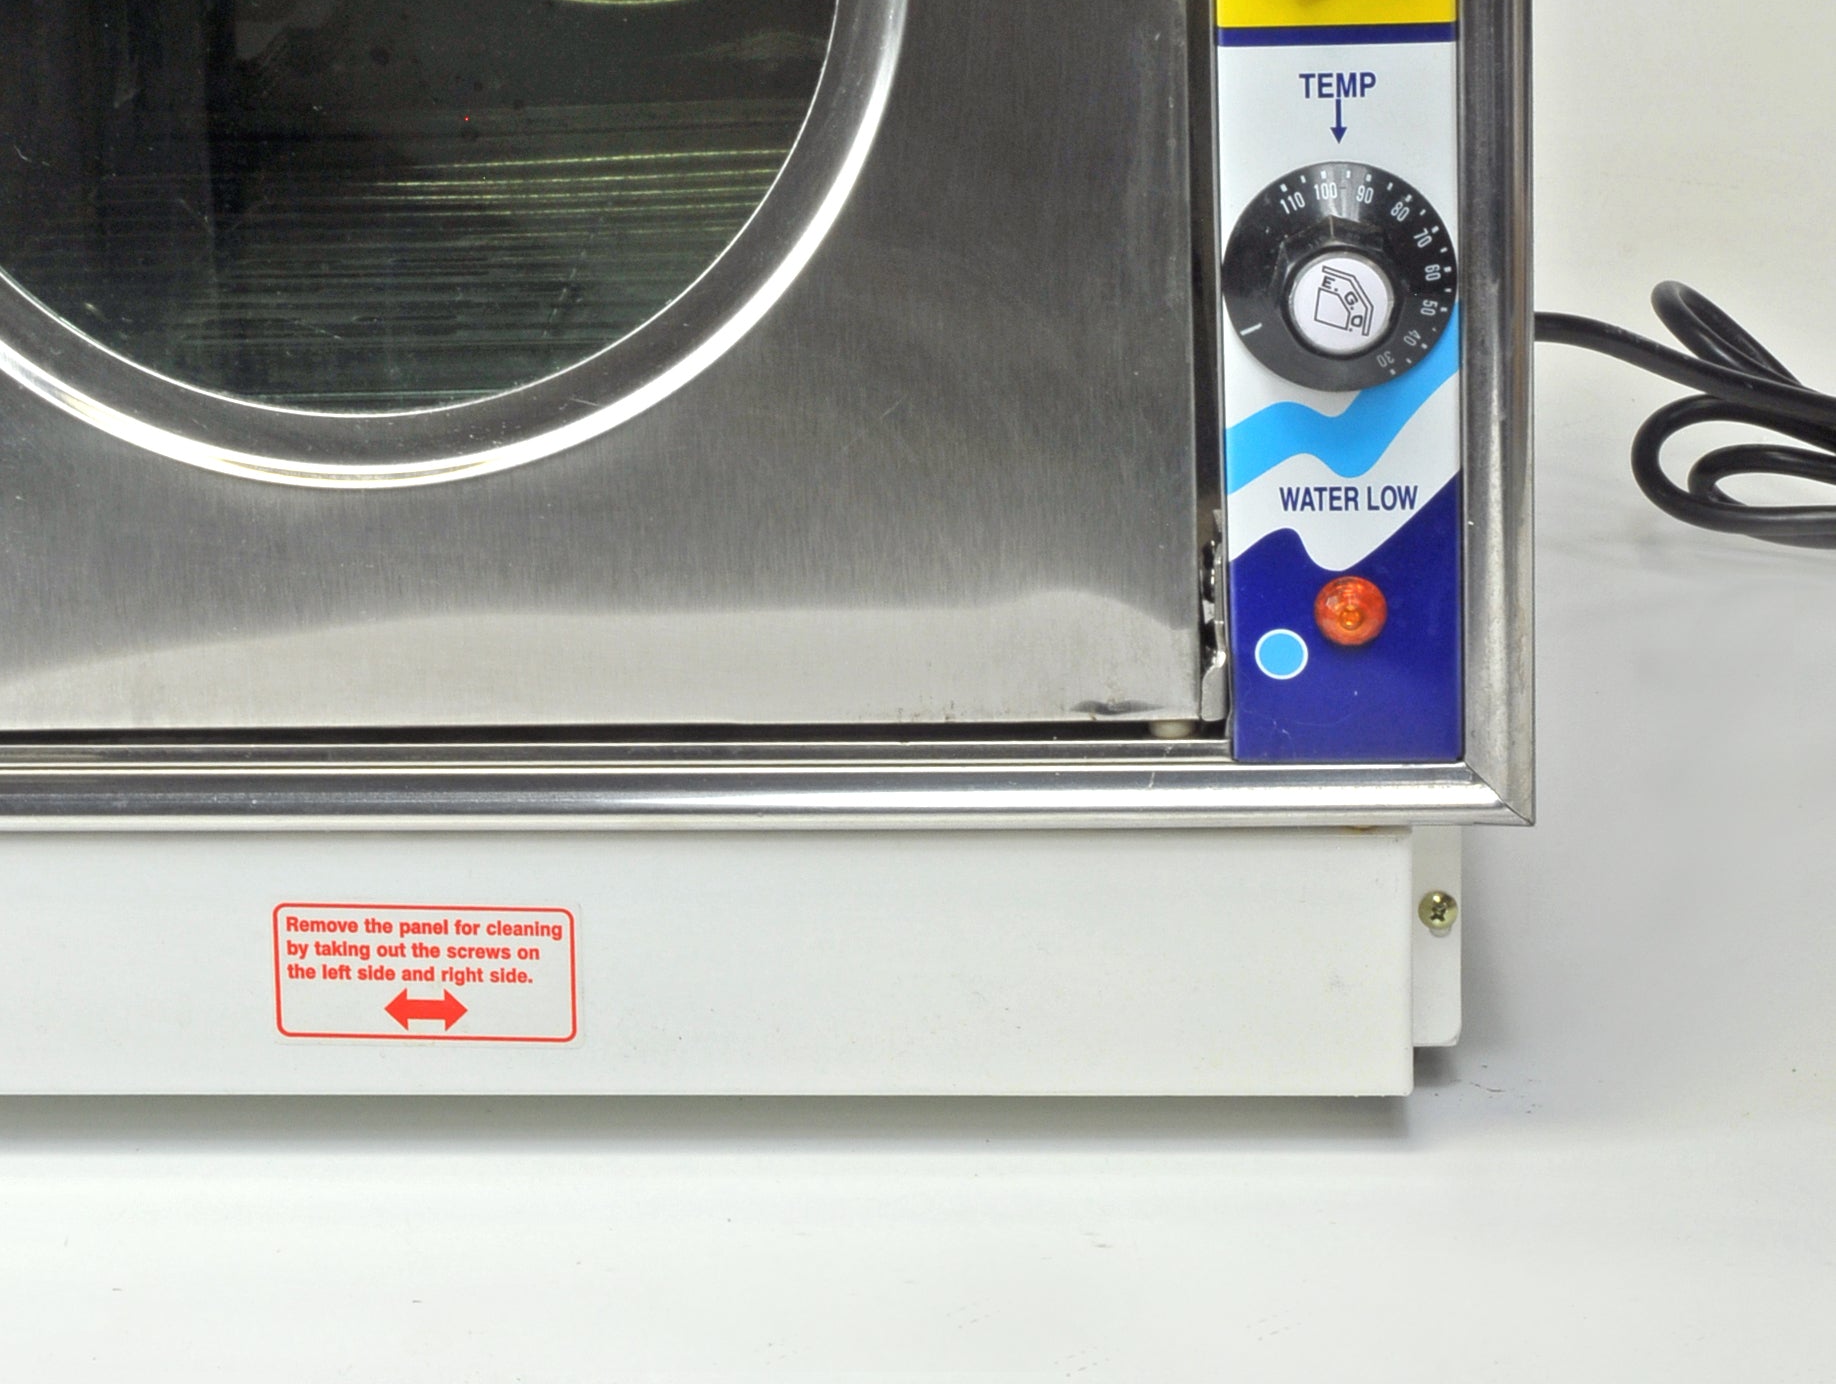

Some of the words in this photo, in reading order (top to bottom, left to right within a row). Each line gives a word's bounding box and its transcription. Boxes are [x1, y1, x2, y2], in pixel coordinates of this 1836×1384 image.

[1298, 72, 1377, 99] TEMP
[1314, 181, 1338, 201] 100
[1356, 185, 1375, 205] 90
[1280, 192, 1306, 215] 110
[1390, 201, 1410, 222] 80
[1413, 228, 1433, 249] 70
[1424, 264, 1442, 282] 60
[1420, 299, 1438, 317] 50
[1403, 329, 1422, 347] 40
[1376, 350, 1396, 368] 30
[1279, 485, 1359, 512] WATER
[1366, 485, 1419, 512] LOW
[286, 916, 359, 933] Remove
[364, 918, 393, 933] the
[399, 919, 449, 937] panel
[454, 919, 480, 935] for
[486, 920, 562, 940] cleaning
[286, 940, 309, 959] by
[314, 940, 370, 960] taking
[376, 942, 406, 957] out
[411, 942, 441, 958] the
[447, 946, 511, 959] screws
[517, 947, 540, 960] on
[287, 963, 316, 979] the
[322, 964, 351, 979] left
[358, 964, 396, 980] side
[402, 966, 435, 982] and
[441, 966, 483, 986] right
[490, 968, 533, 984] side.
